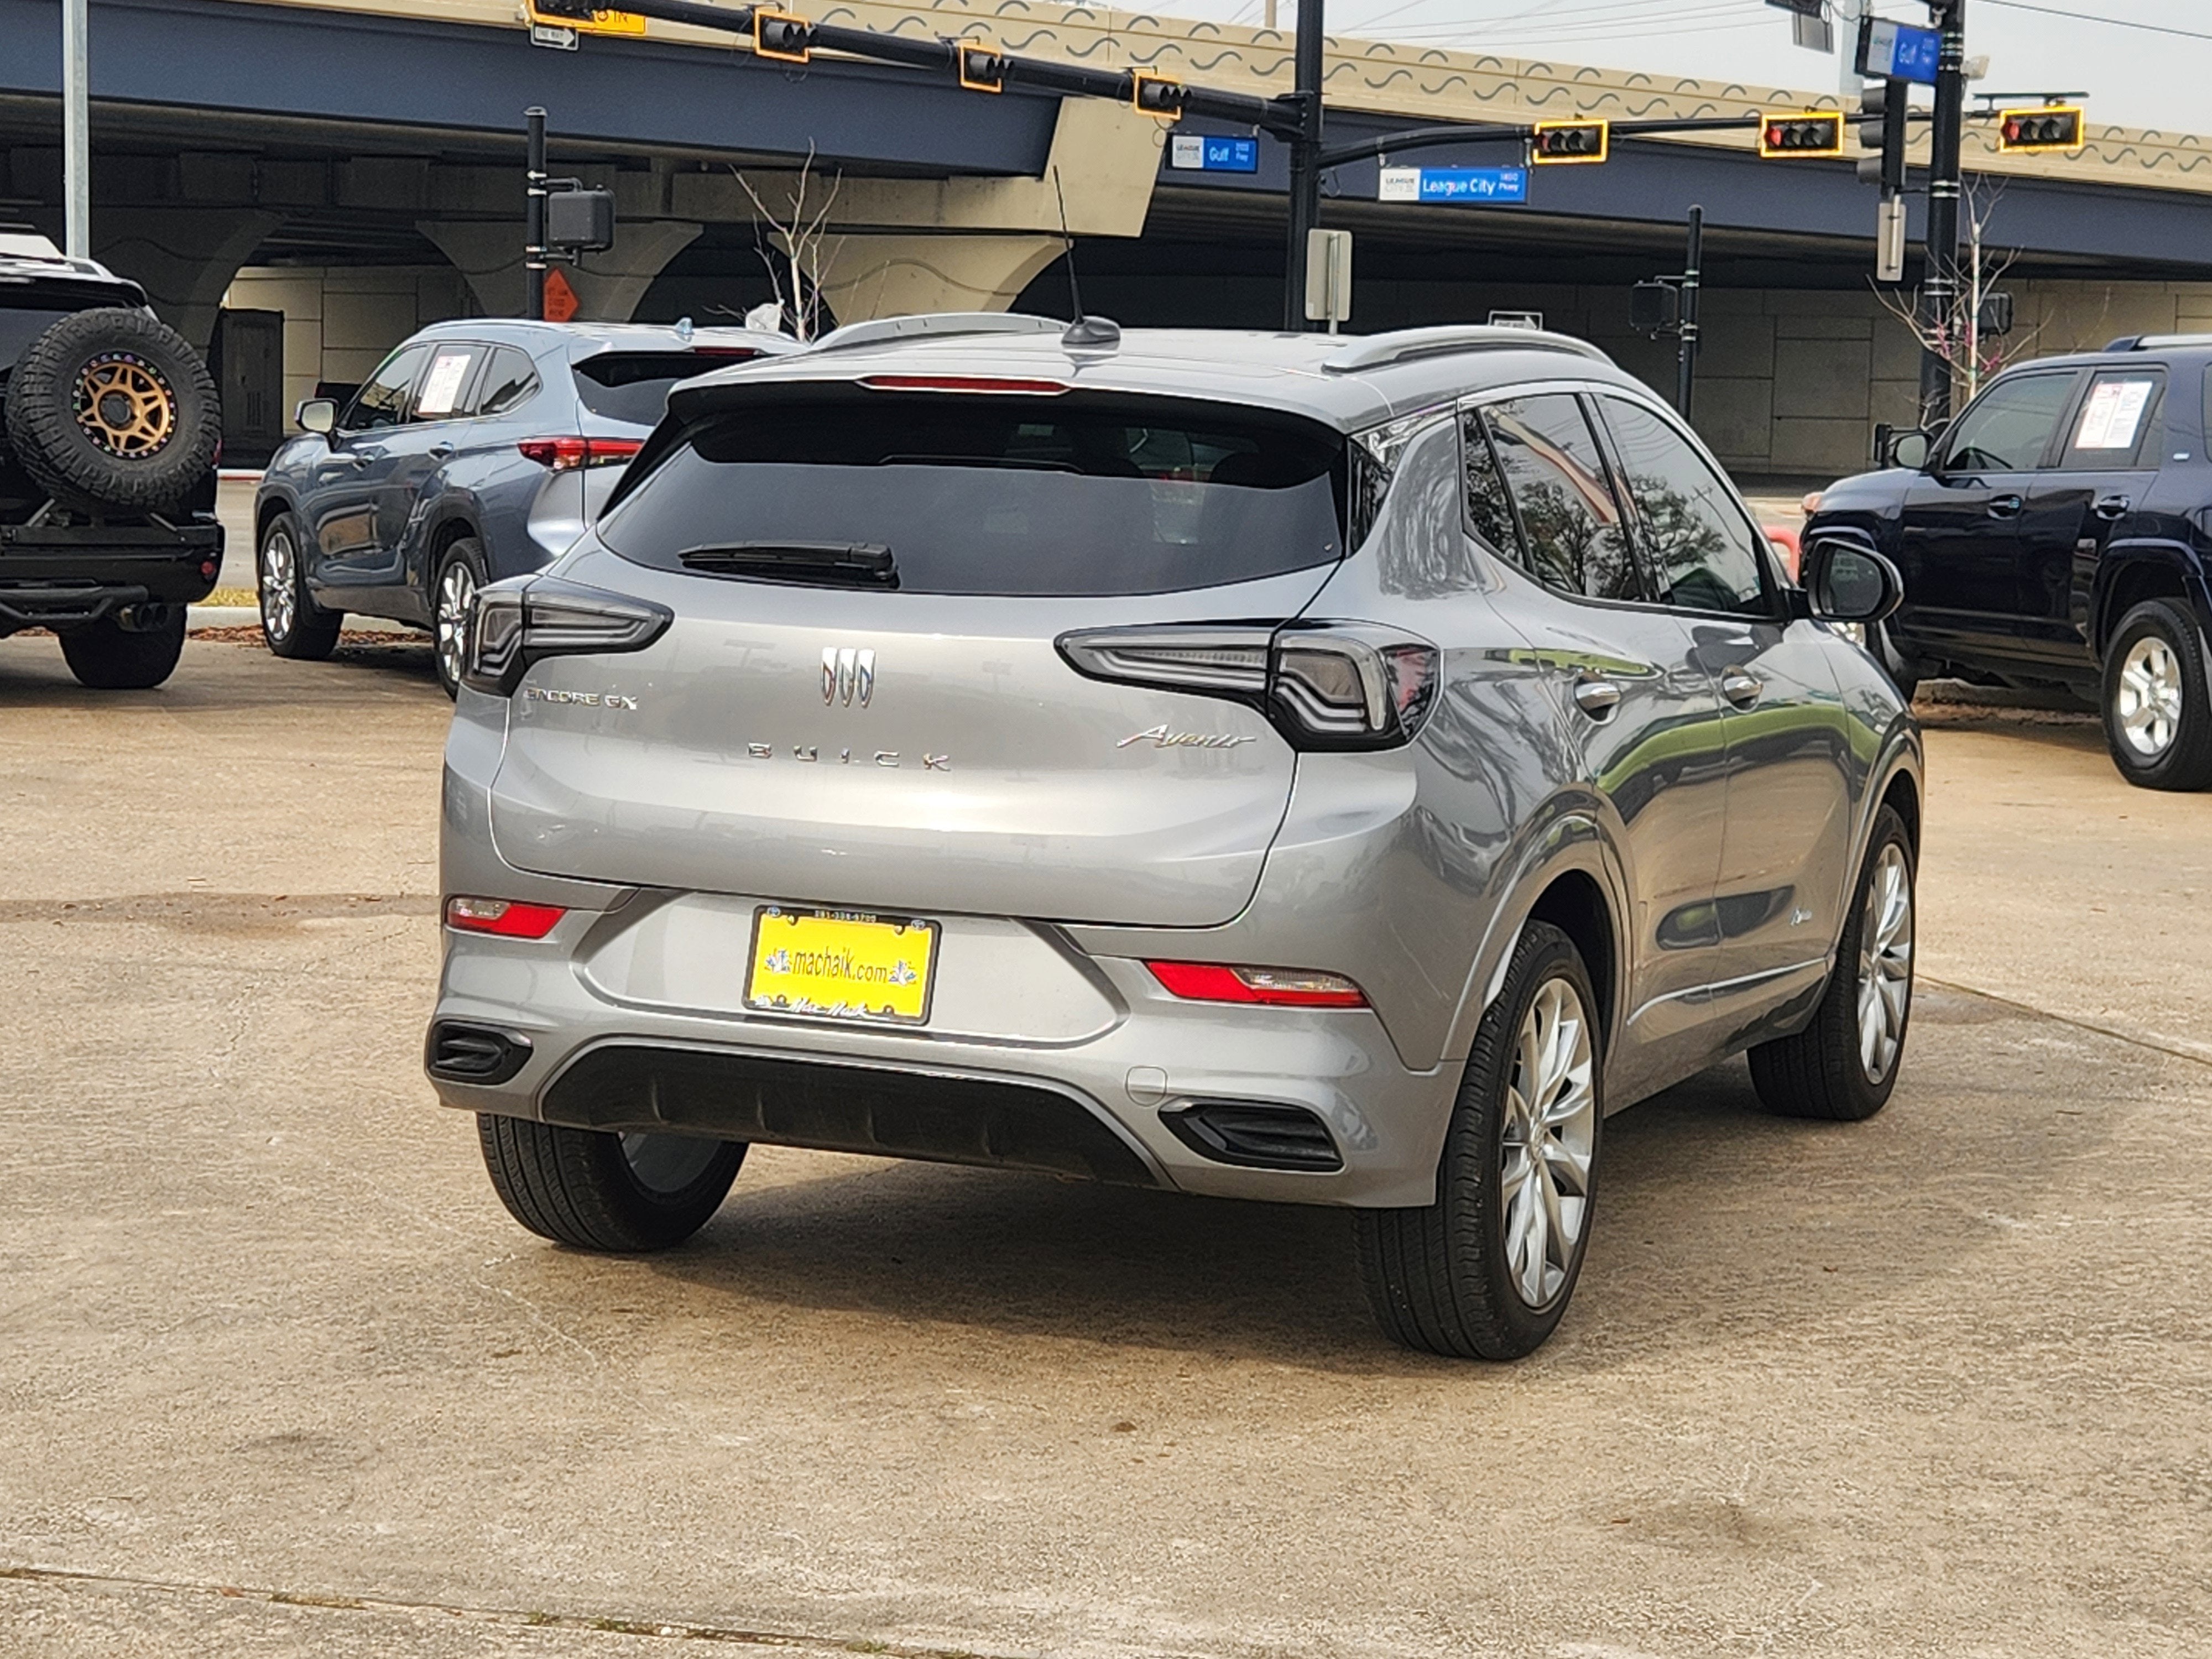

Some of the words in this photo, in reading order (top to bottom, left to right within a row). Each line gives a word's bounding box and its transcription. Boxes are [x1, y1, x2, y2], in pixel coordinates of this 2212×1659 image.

[1422, 178, 1468, 196] League
[1469, 178, 1496, 196] City
[524, 687, 601, 706] ENCORE
[604, 694, 638, 710] GX
[748, 742, 951, 771] BUICK
[792, 946, 888, 983] machaik.com
